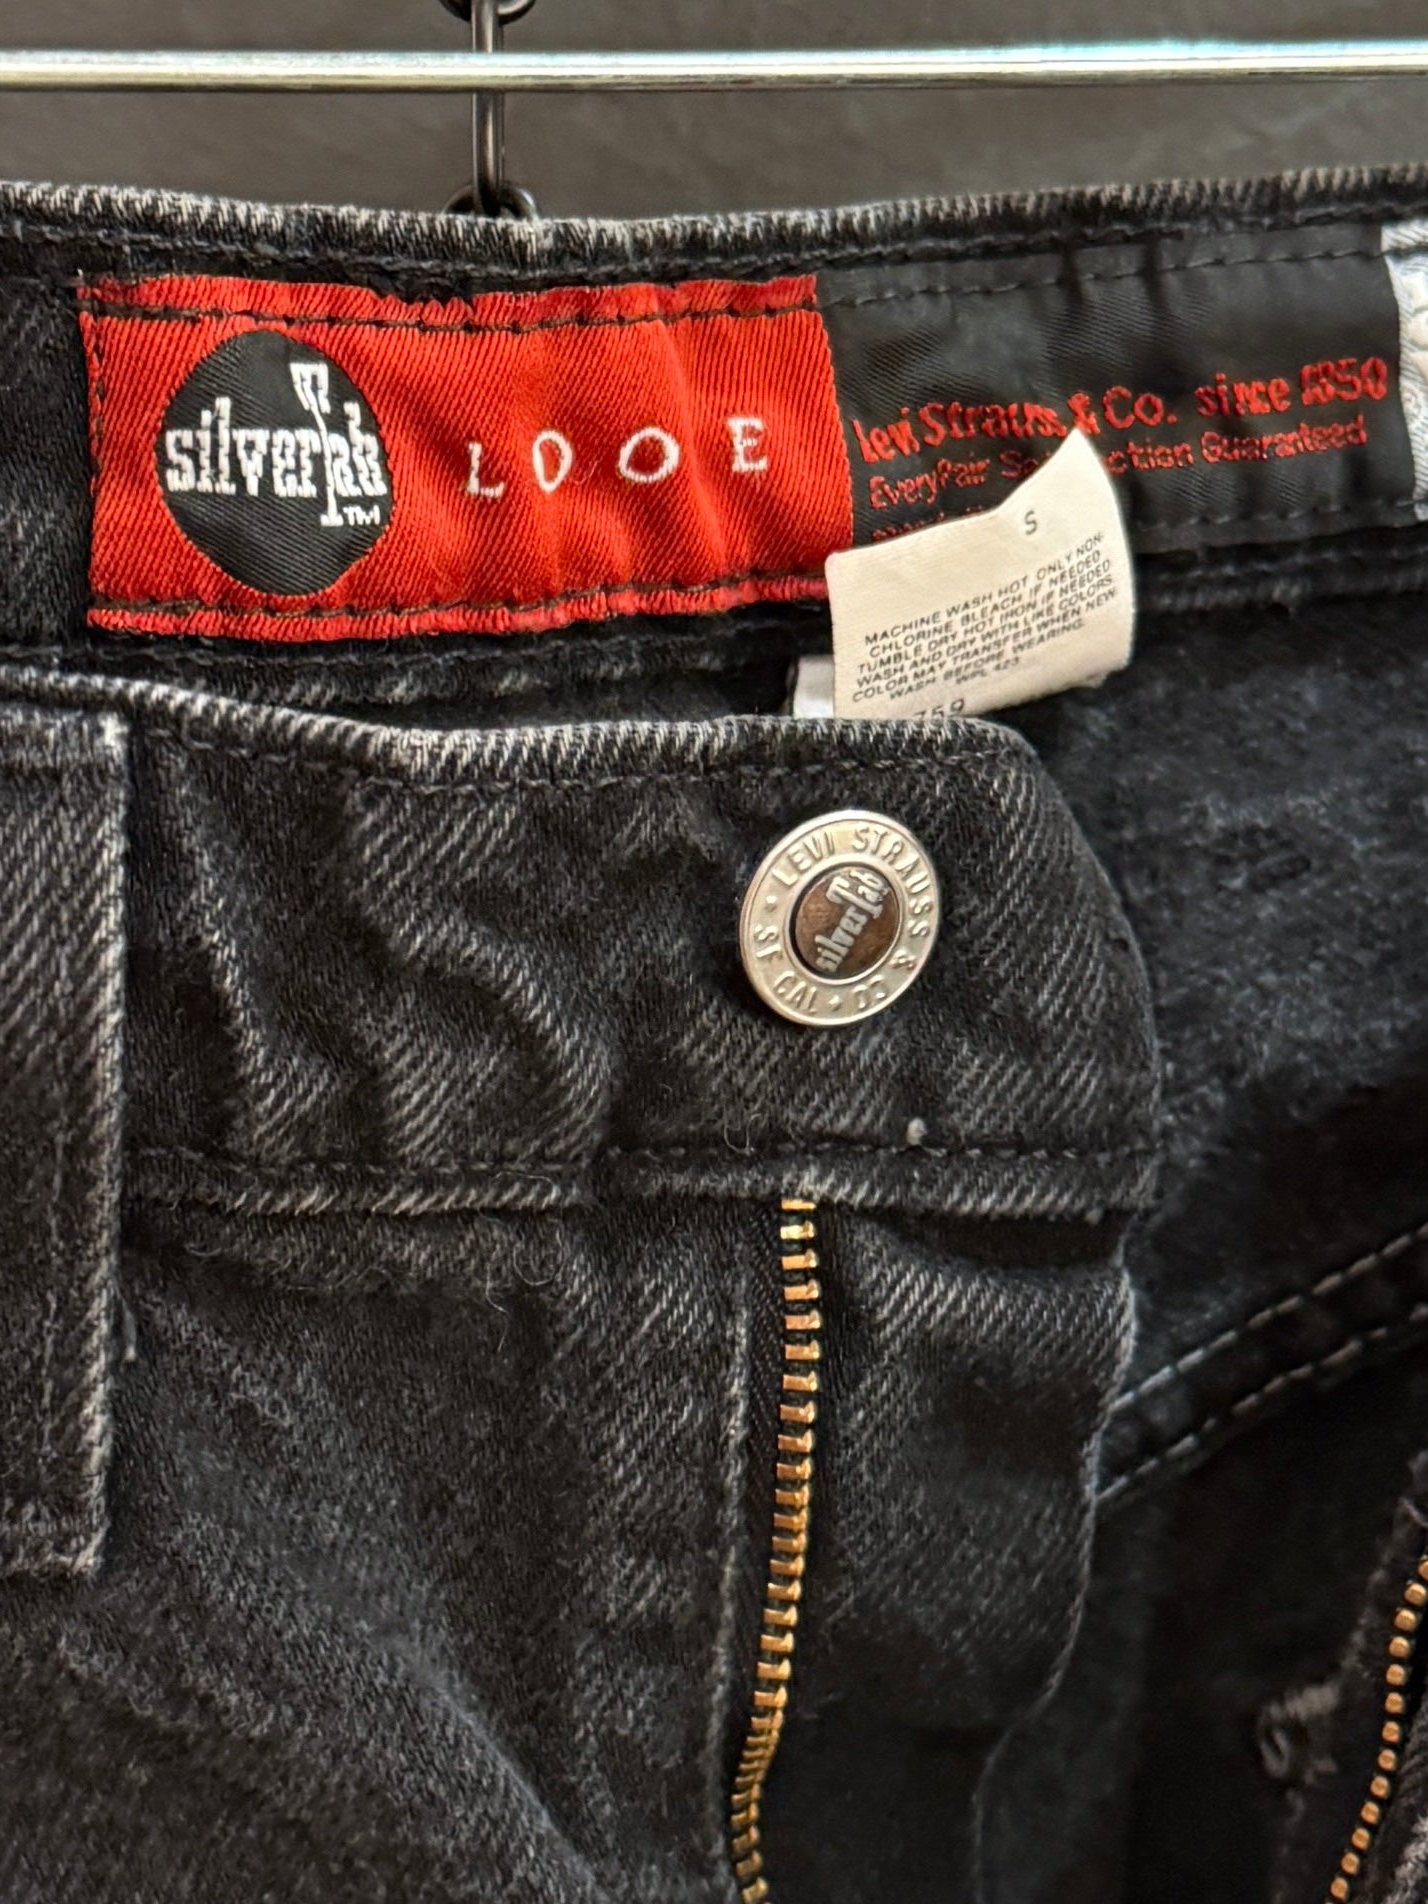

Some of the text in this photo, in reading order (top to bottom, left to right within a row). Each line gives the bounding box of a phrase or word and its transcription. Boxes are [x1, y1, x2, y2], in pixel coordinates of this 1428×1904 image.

[851, 405, 920, 464] Levi
[917, 400, 1068, 447] Strauss
[1067, 390, 1101, 435] &
[1103, 385, 1177, 429] Co.
[1194, 372, 1291, 417] since
[1200, 413, 1367, 464] Guaranteed
[1024, 509, 1038, 536] S
[858, 558, 1111, 675] TUMBLE DRY HOT IRON IF NEEDED
[865, 610, 941, 646] MACHINE
[946, 593, 993, 618] WASH
[997, 575, 1028, 597] HOT
[1036, 553, 1073, 581] ONLY
[869, 549, 1101, 659] CHLORINE BLEACH IF NEEDED
[852, 673, 909, 703] COLOR
[913, 661, 947, 682] MAY
[952, 626, 1033, 665] TRANSFER
[1036, 606, 1082, 633] WHEN
[857, 663, 905, 688] WASH
[909, 650, 942, 670] AND
[946, 636, 976, 657] DRY
[981, 621, 1020, 643] WITH
[1023, 604, 1056, 627] LIKE
[889, 676, 937, 700] WASH
[943, 649, 1005, 682] BEFORE
[771, 830, 836, 887] LEVI
[851, 826, 934, 938] STRAUSS
